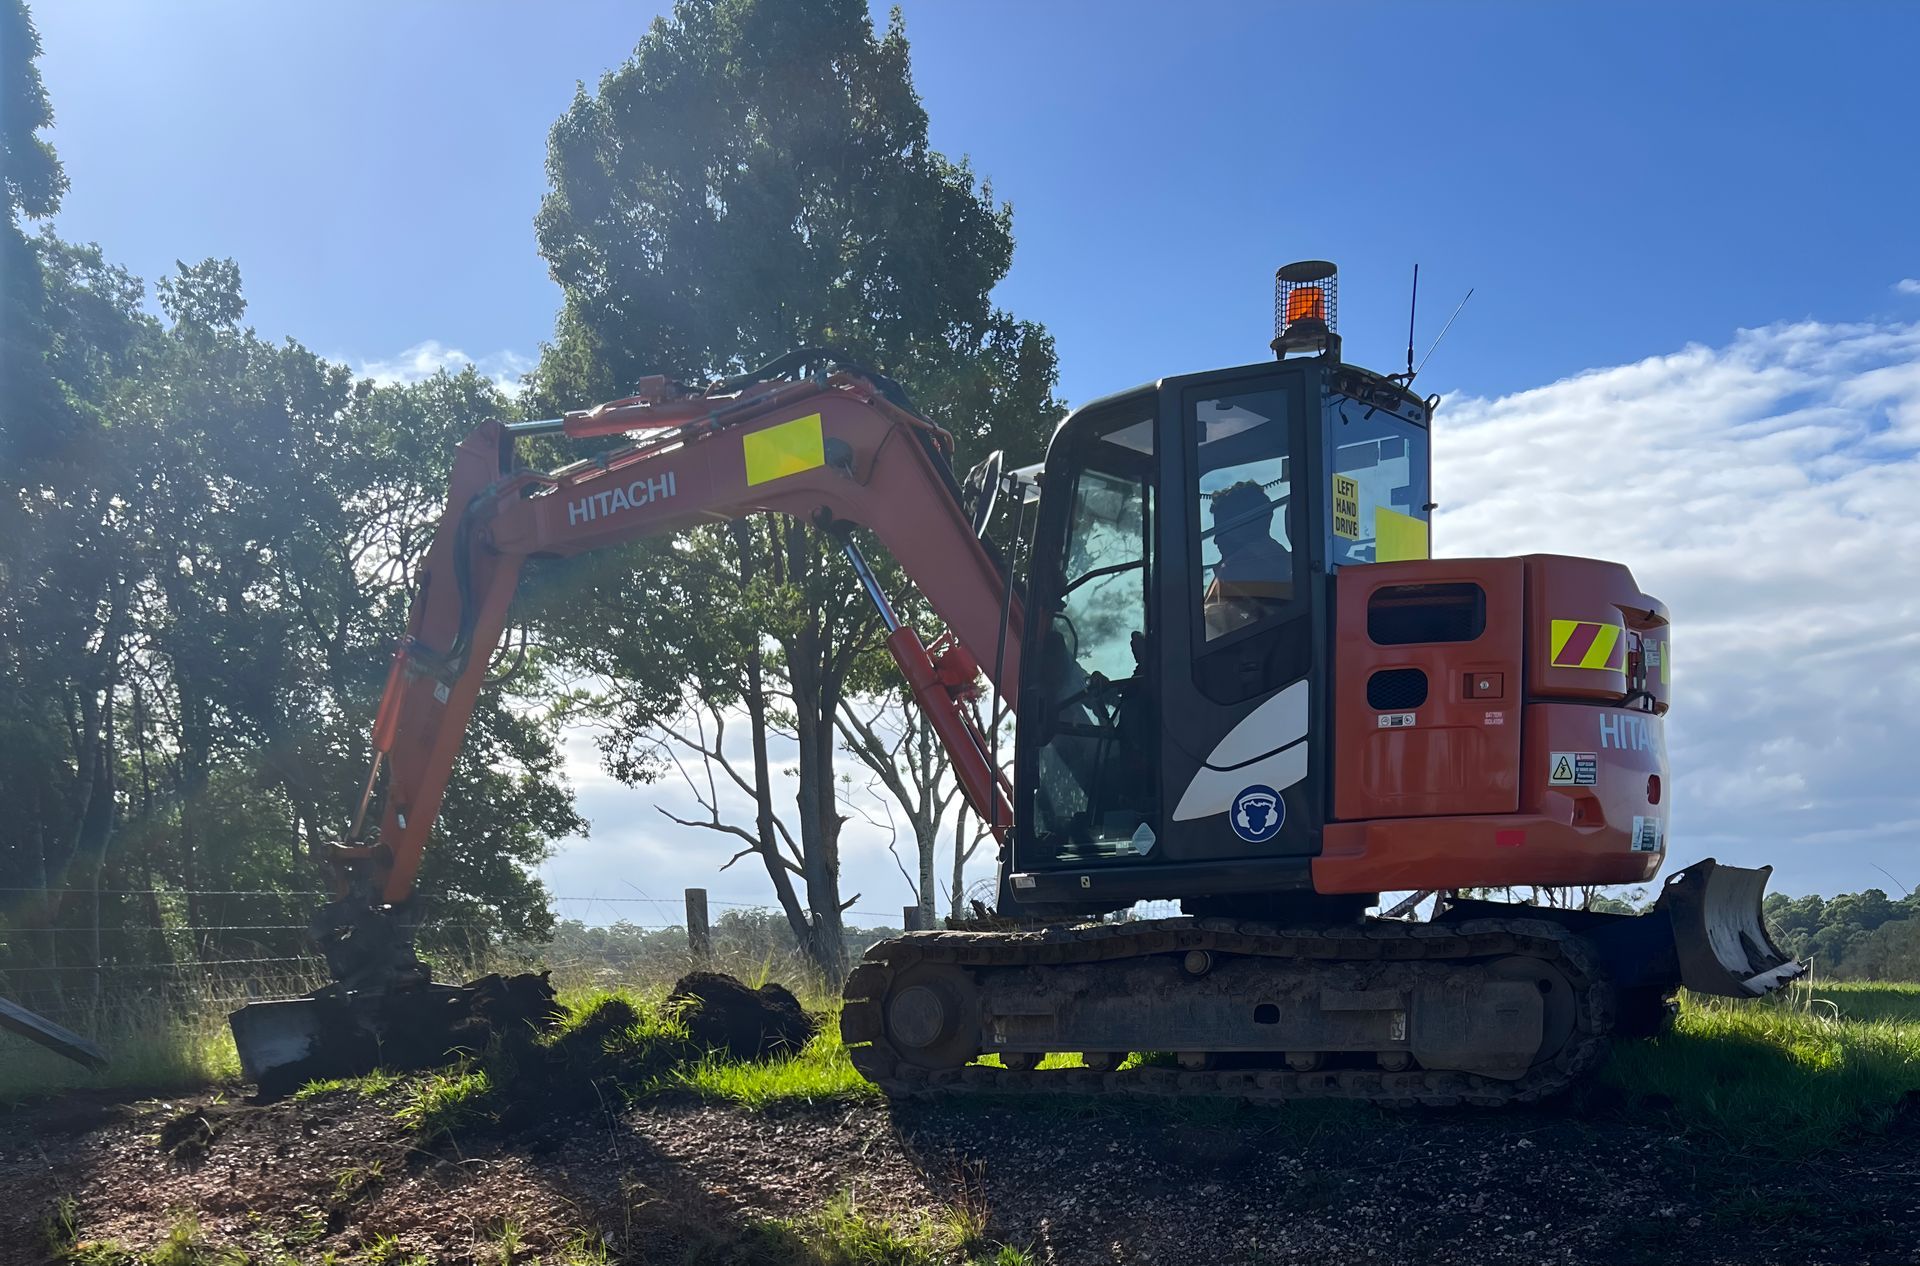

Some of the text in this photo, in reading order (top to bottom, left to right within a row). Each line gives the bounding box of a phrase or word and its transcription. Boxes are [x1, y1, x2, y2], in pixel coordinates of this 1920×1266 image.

[1337, 479, 1354, 498] LEFT
[568, 471, 676, 526] HITACHI
[1336, 498, 1356, 517] HAND
[1336, 516, 1357, 536] DRIVE
